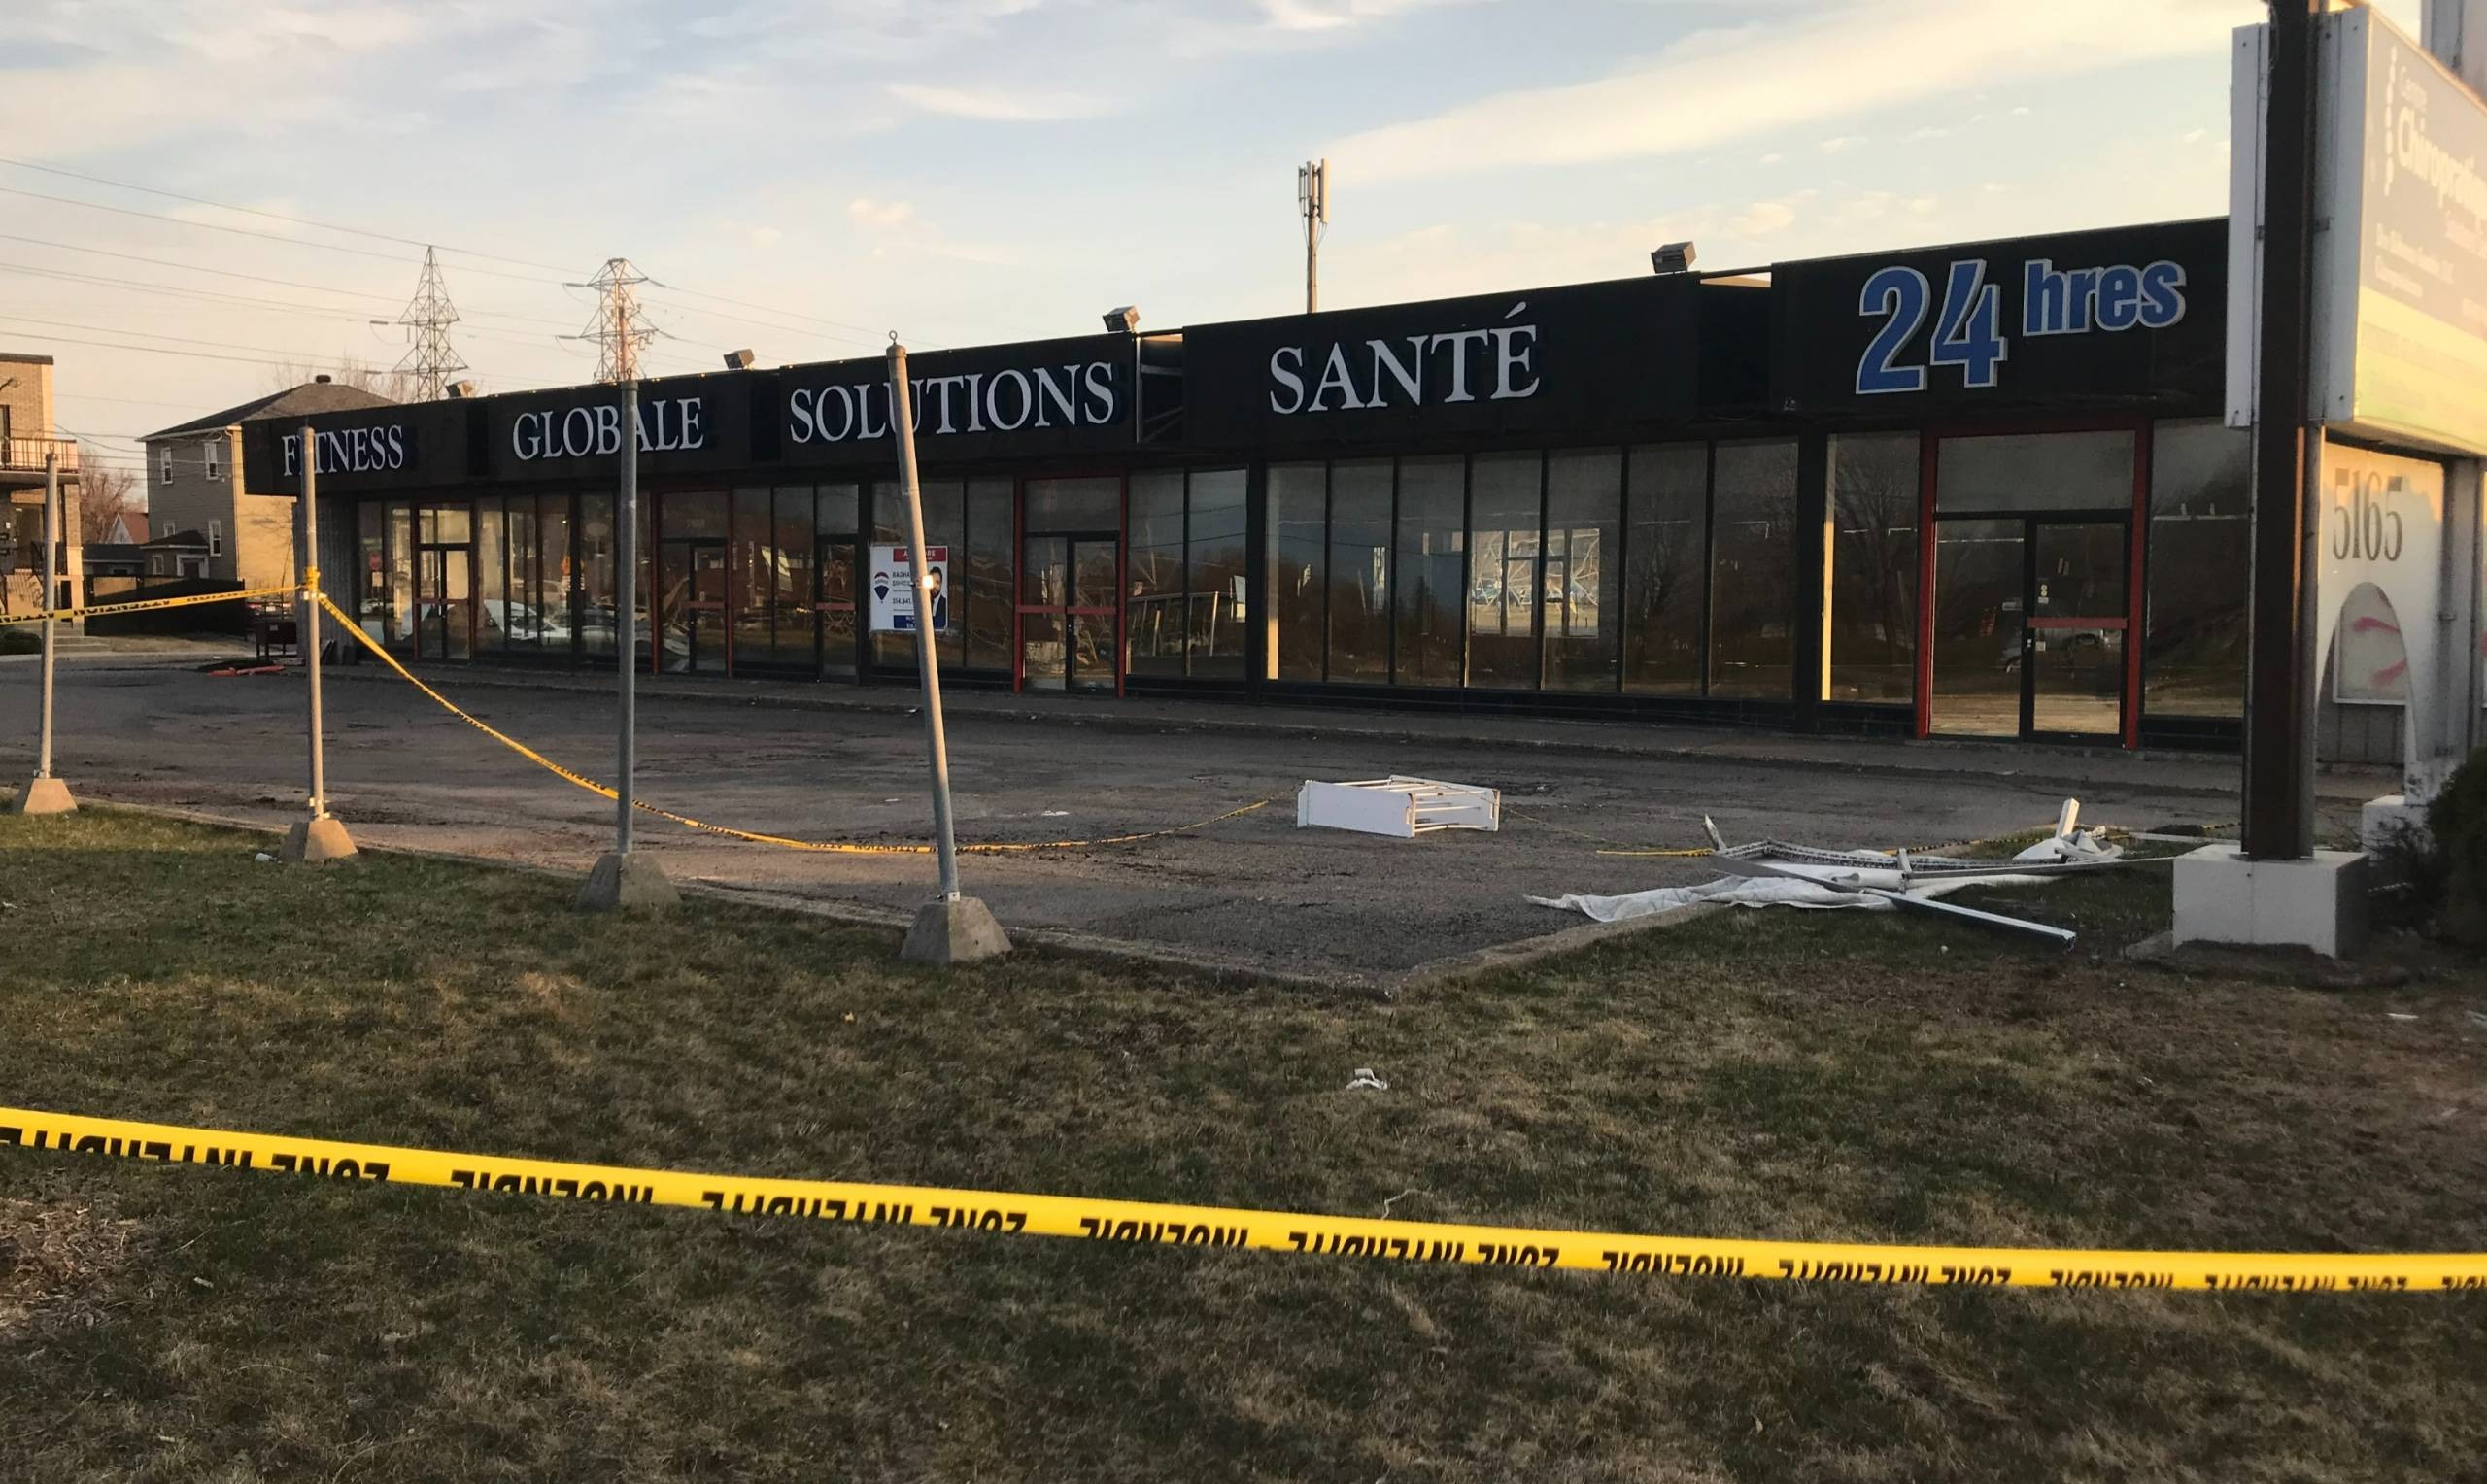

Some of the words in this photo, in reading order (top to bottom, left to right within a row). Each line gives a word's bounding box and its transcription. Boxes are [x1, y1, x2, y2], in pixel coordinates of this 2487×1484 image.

[1269, 301, 1540, 414] SANTÉ
[1855, 257, 2008, 395] 24
[2022, 257, 2187, 337] hres
[789, 361, 1115, 444] SOLUTIONS
[281, 424, 404, 477] FTNESS
[2333, 466, 2403, 561] 5165
